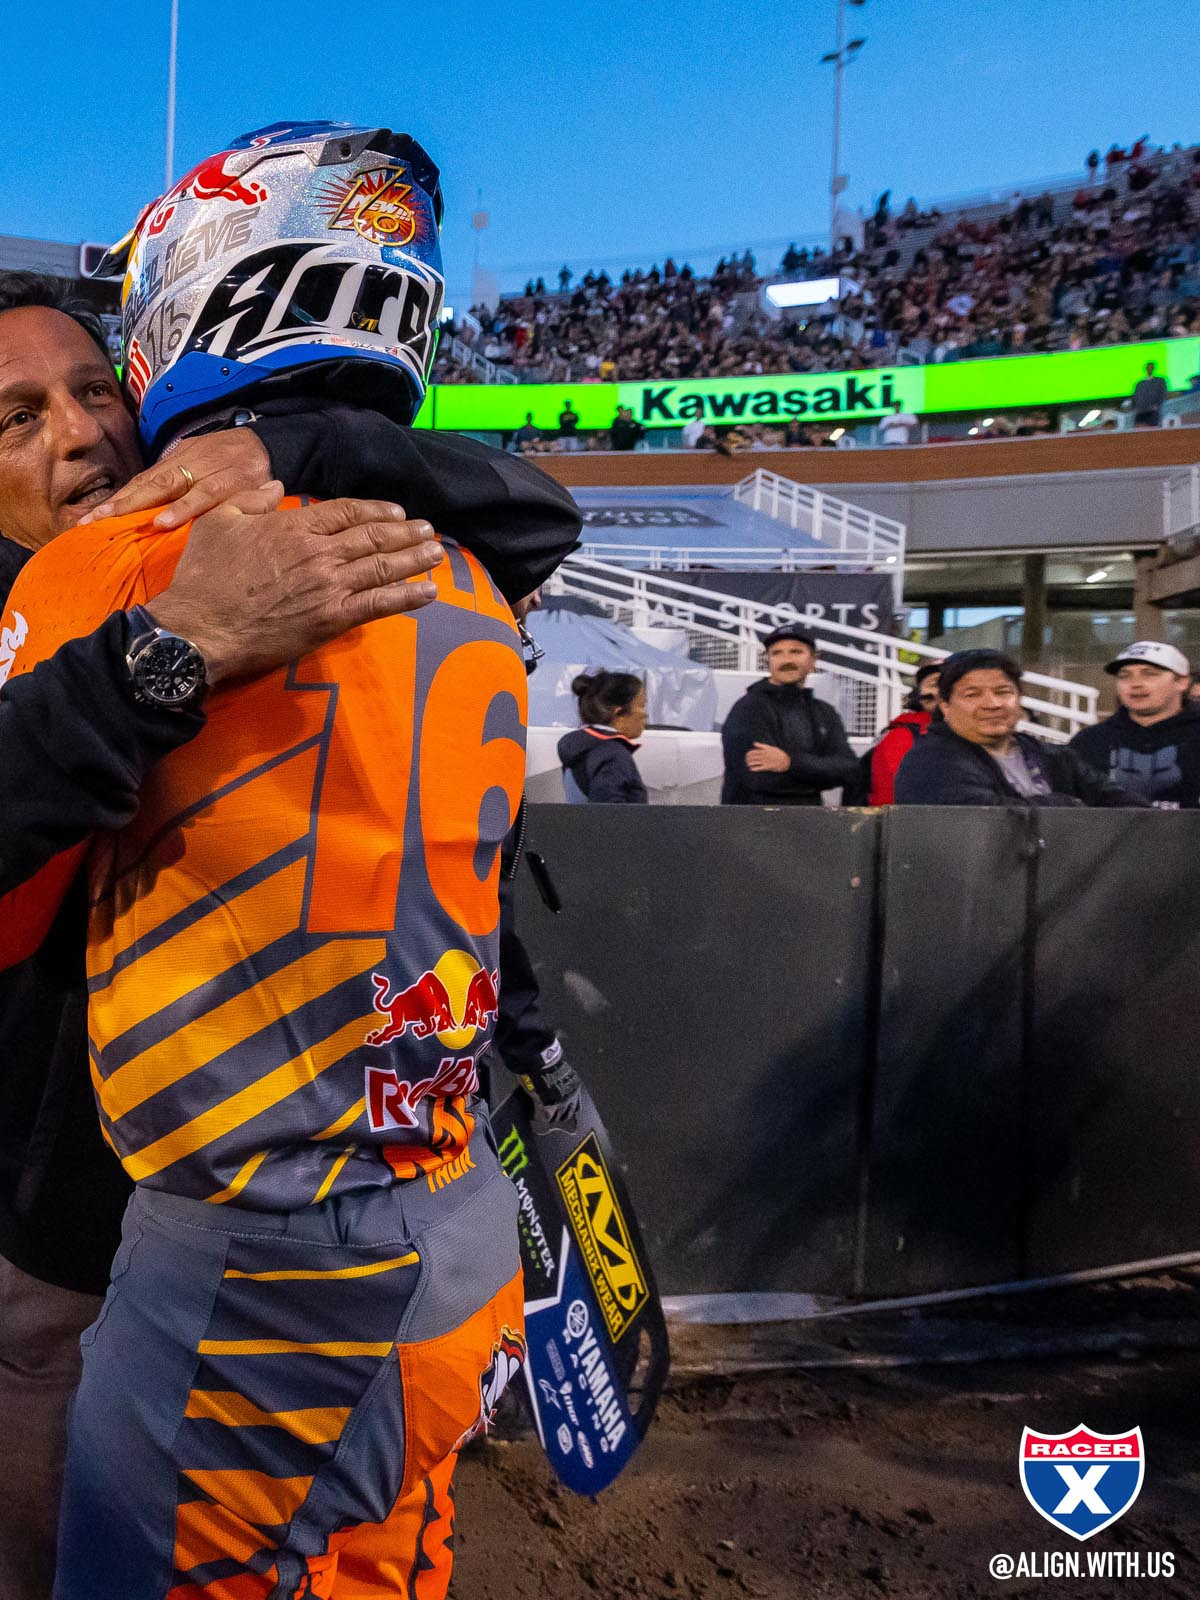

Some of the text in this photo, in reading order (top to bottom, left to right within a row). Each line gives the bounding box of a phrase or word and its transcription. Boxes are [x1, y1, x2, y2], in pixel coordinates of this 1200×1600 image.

[641, 374, 895, 420] Kawasaki
[287, 612, 528, 936] 16
[516, 1177, 555, 1278] MONSTER
[560, 1166, 625, 1334] MECHANIX WEAR
[577, 1326, 627, 1452] YAMAHA
